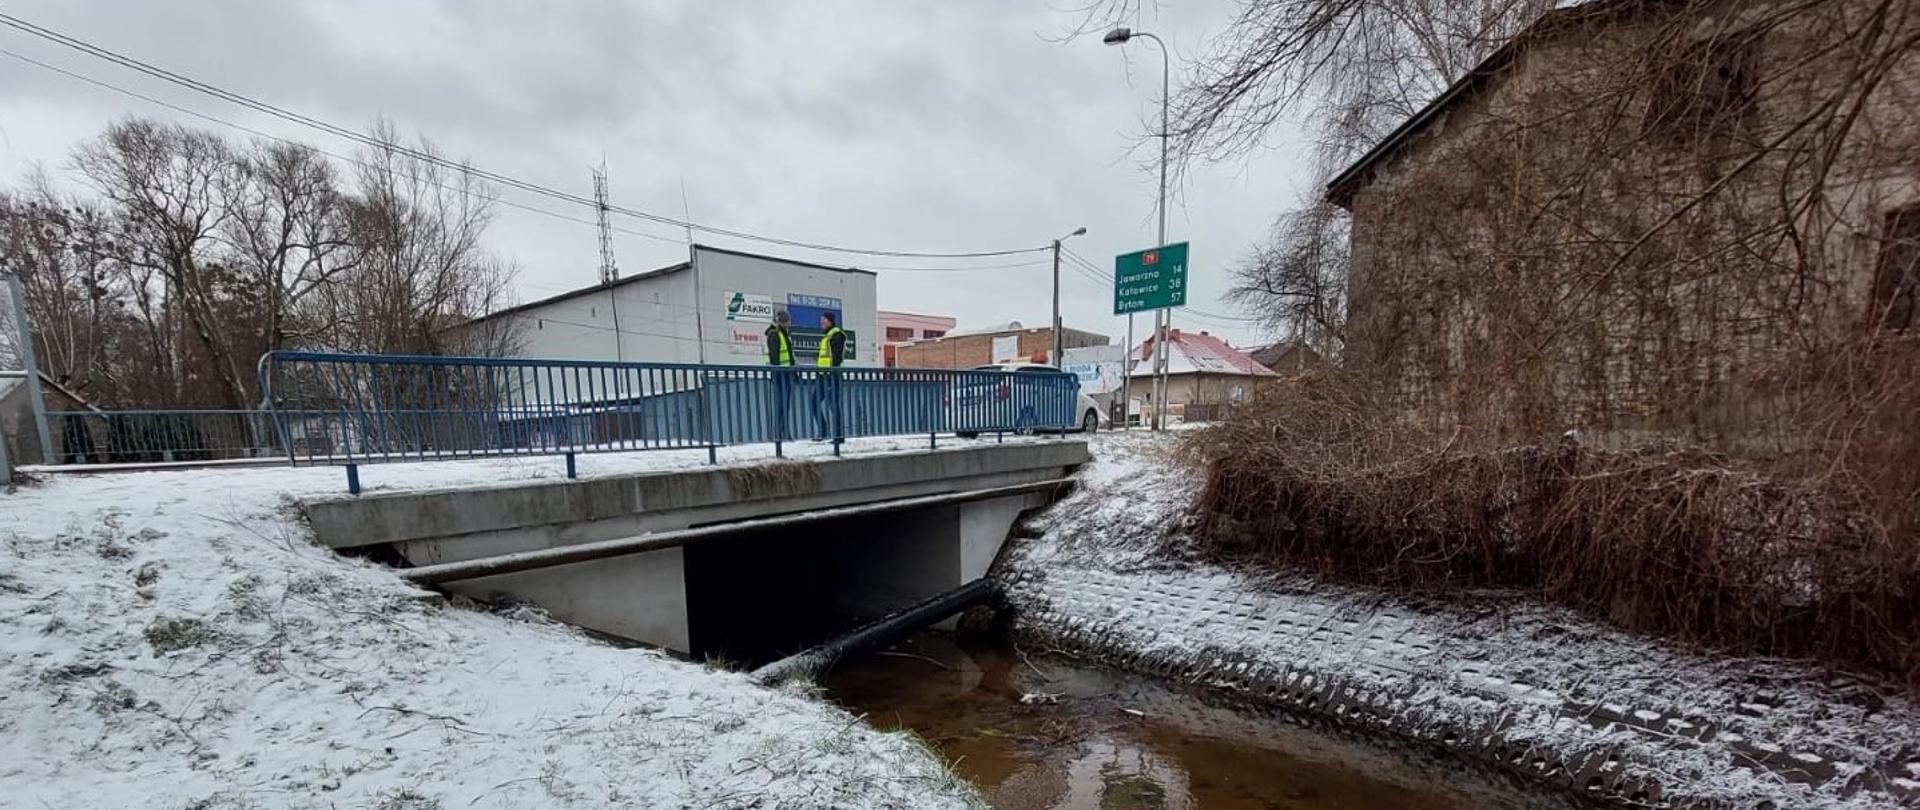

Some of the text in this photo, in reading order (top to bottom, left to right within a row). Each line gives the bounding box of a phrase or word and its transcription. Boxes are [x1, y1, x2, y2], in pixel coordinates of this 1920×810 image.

[1119, 264, 1182, 284] Jaworzno 14
[1119, 284, 1159, 296] Katowice
[1118, 300, 1144, 311] Bytom
